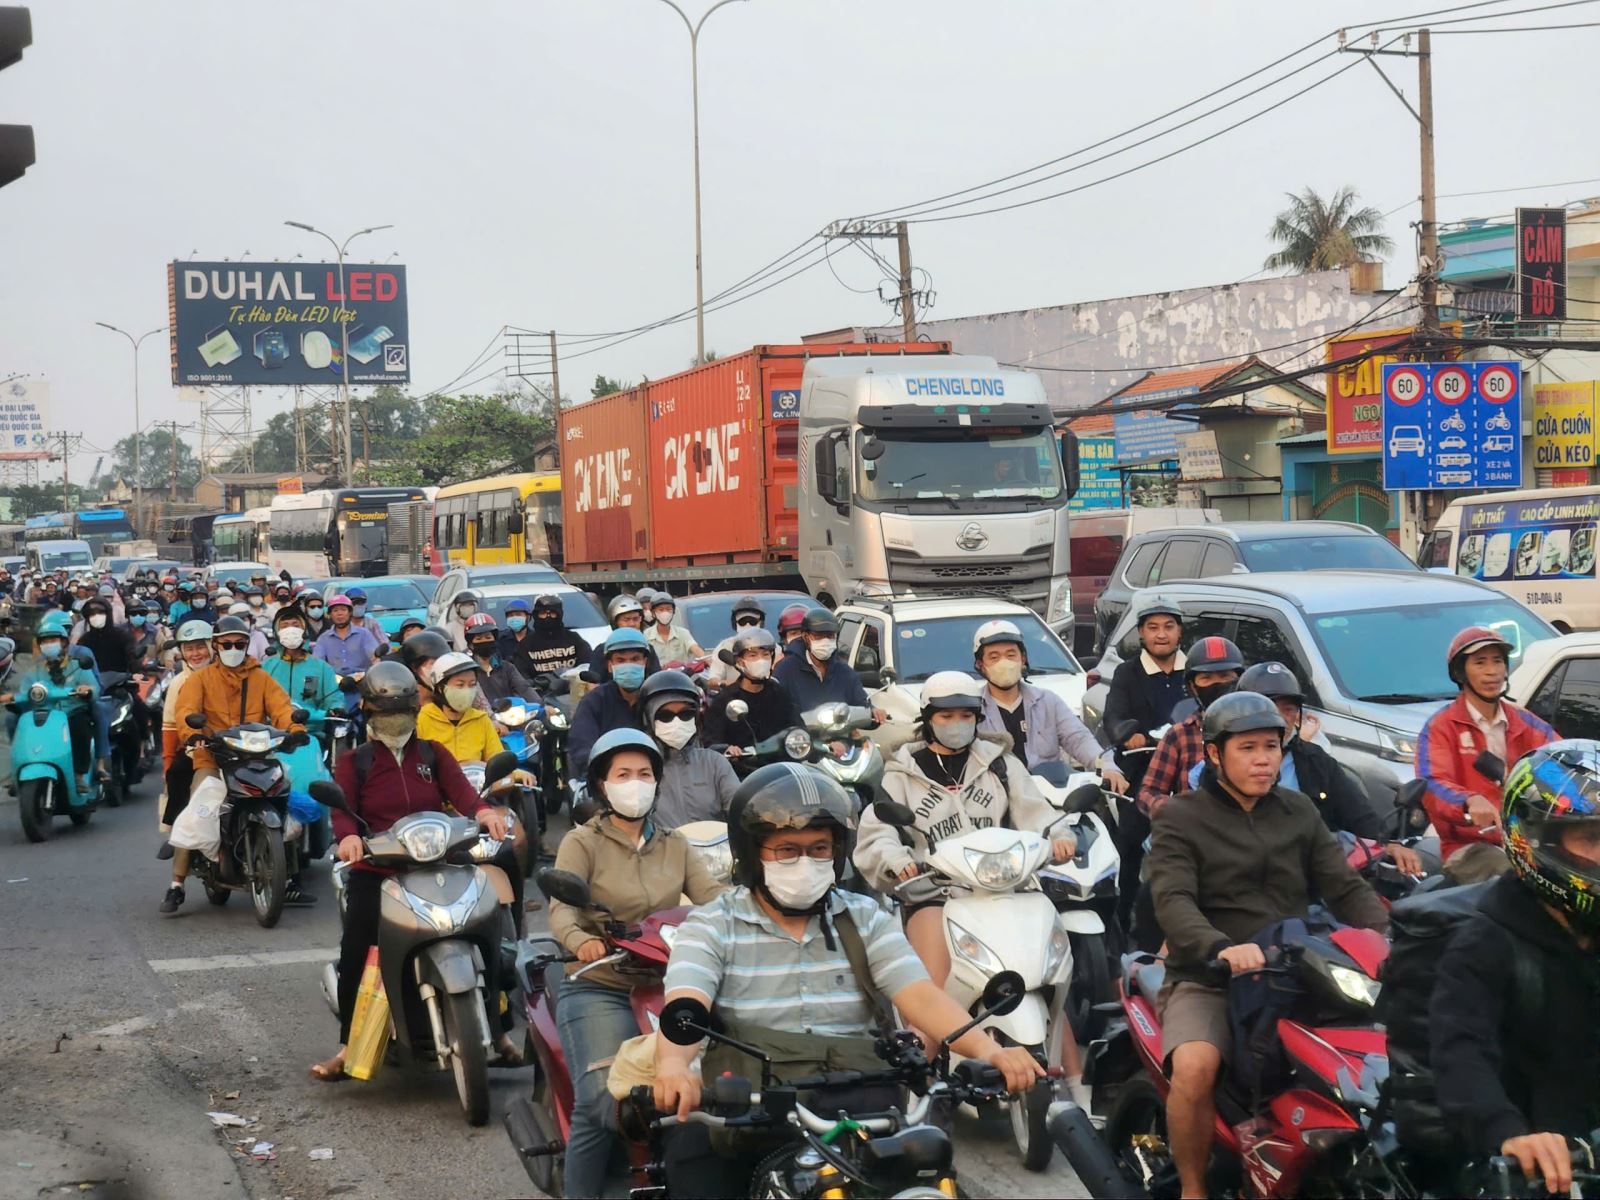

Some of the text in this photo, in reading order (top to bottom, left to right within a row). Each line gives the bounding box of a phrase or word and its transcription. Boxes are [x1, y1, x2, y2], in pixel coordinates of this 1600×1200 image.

[184, 270, 398, 301] DUHAL LED
[300, 306, 329, 323] LED
[906, 378, 1004, 396] CHENGLONG
[1398, 379, 1413, 393] 60
[1444, 378, 1459, 393] 60
[1489, 377, 1505, 392] 60
[786, 410, 801, 418] LIN
[1353, 404, 1383, 427] NGỌ
[1536, 412, 1558, 435] CỬA
[1537, 440, 1591, 463] CỬA KÉO
[1520, 508, 1537, 521] CAO
[1555, 505, 1575, 518] LINH
